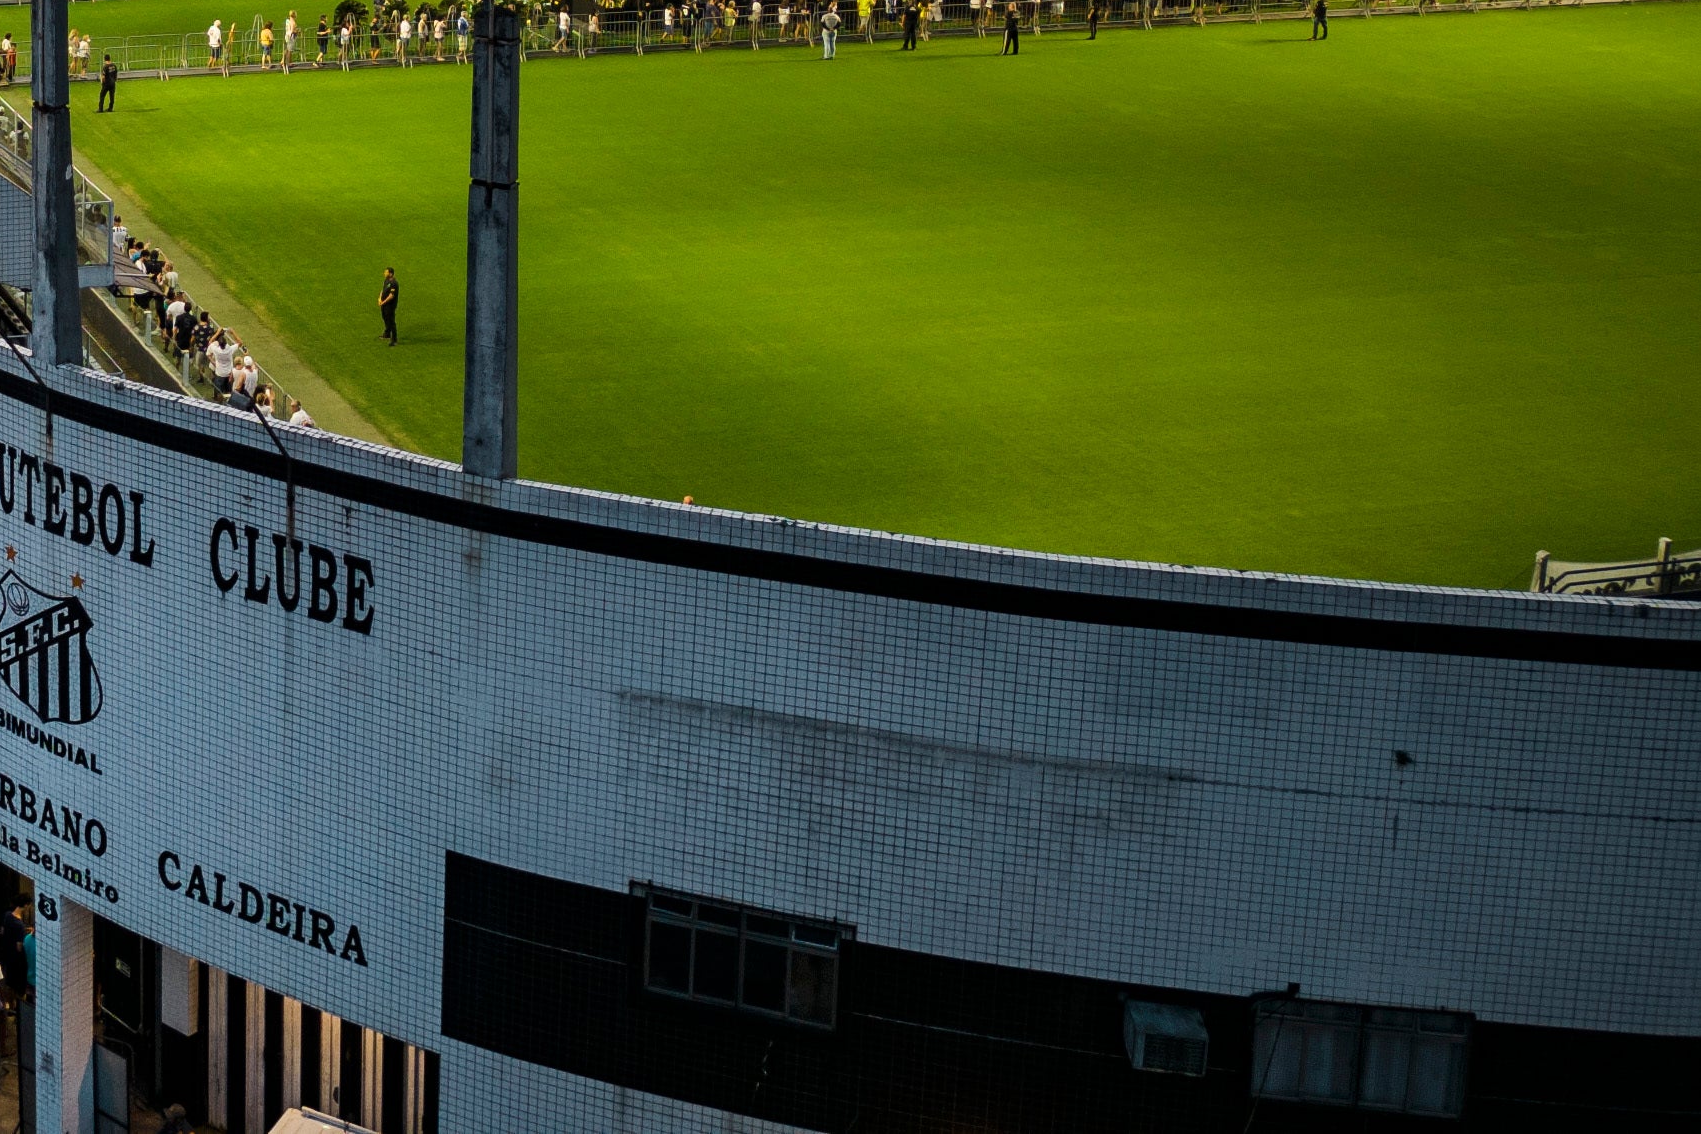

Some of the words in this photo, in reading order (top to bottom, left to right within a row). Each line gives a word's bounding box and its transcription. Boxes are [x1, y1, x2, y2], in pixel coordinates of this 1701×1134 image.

[210, 517, 374, 635] CLUBE
[26, 840, 120, 905] Belmiro
[158, 850, 368, 967] CALDEIRA
